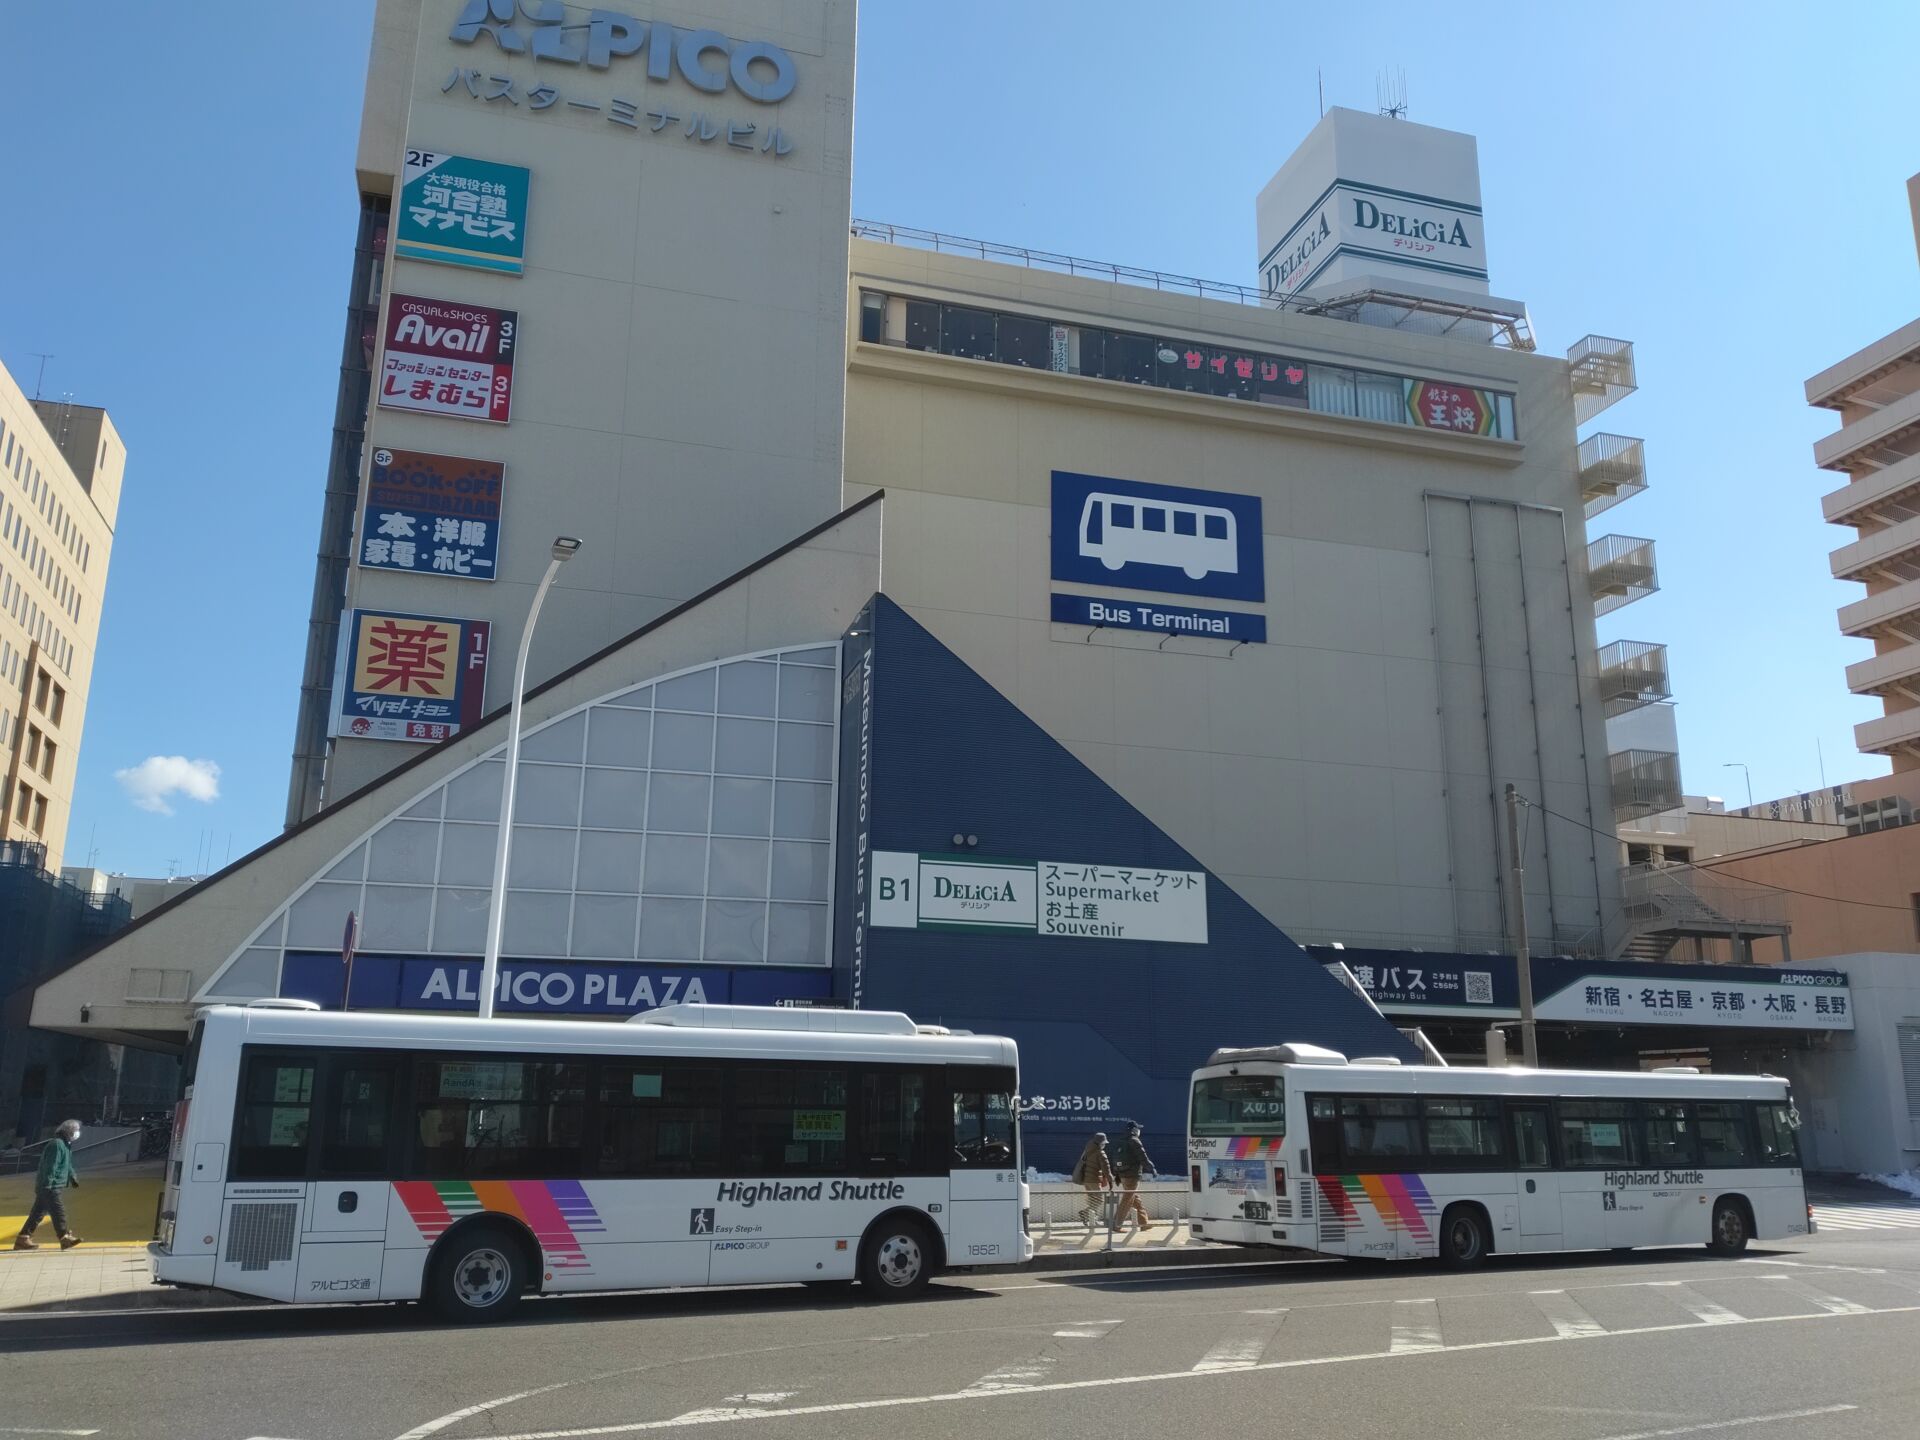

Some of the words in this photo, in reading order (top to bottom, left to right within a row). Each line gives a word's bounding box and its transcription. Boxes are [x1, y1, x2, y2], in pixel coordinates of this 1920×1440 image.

[440, 66, 795, 157] バスターミナルビル
[406, 151, 434, 168] 2F
[426, 172, 507, 196] 大学現役合格
[421, 184, 508, 218] 河合塾
[408, 205, 516, 242] マナビス
[1393, 238, 1435, 253] デリシア
[394, 314, 491, 354] Avail
[386, 358, 490, 382] ファッションセンター
[1184, 350, 1304, 385] サイゼリヤ
[383, 373, 490, 409] しまむら
[1429, 402, 1476, 431] 王将
[376, 453, 391, 463] 5F
[1089, 602, 1131, 624] Bus
[1136, 607, 1230, 634] Terminal
[366, 620, 448, 696] 薬
[355, 696, 452, 719] マツモトキヨシ
[411, 722, 445, 739] 免税
[859, 647, 872, 824] Matsumoto
[1783, 797, 1823, 814] TABINO
[1824, 792, 1853, 805] HOTEL
[856, 832, 867, 895] Bus
[1045, 865, 1198, 889] スーパーマーケット
[879, 876, 911, 902] B1
[1045, 881, 1160, 904] Supermarket
[960, 901, 990, 910] デリシア
[1046, 902, 1099, 922] お土産
[1045, 918, 1125, 937] Souvenir
[584, 973, 709, 1007] PLAZA
[1433, 982, 1459, 990] こちらから
[1780, 974, 1814, 985] ALPICO
[1815, 975, 1843, 987] GROUP
[1367, 990, 1406, 1000] Highway
[1409, 991, 1427, 1000] Bus
[1188, 1139, 1217, 1149] Highland
[1604, 1171, 1660, 1190] Highland
[1663, 1170, 1704, 1184] Shuttle
[717, 1182, 823, 1208] Highland
[829, 1181, 905, 1200] Shuttle
[715, 1225, 733, 1234] Easy
[735, 1225, 762, 1233] Step-in
[745, 1242, 770, 1250] GROUP
[968, 1244, 1000, 1255] 18521
[311, 1278, 371, 1291] アルピコ交通
